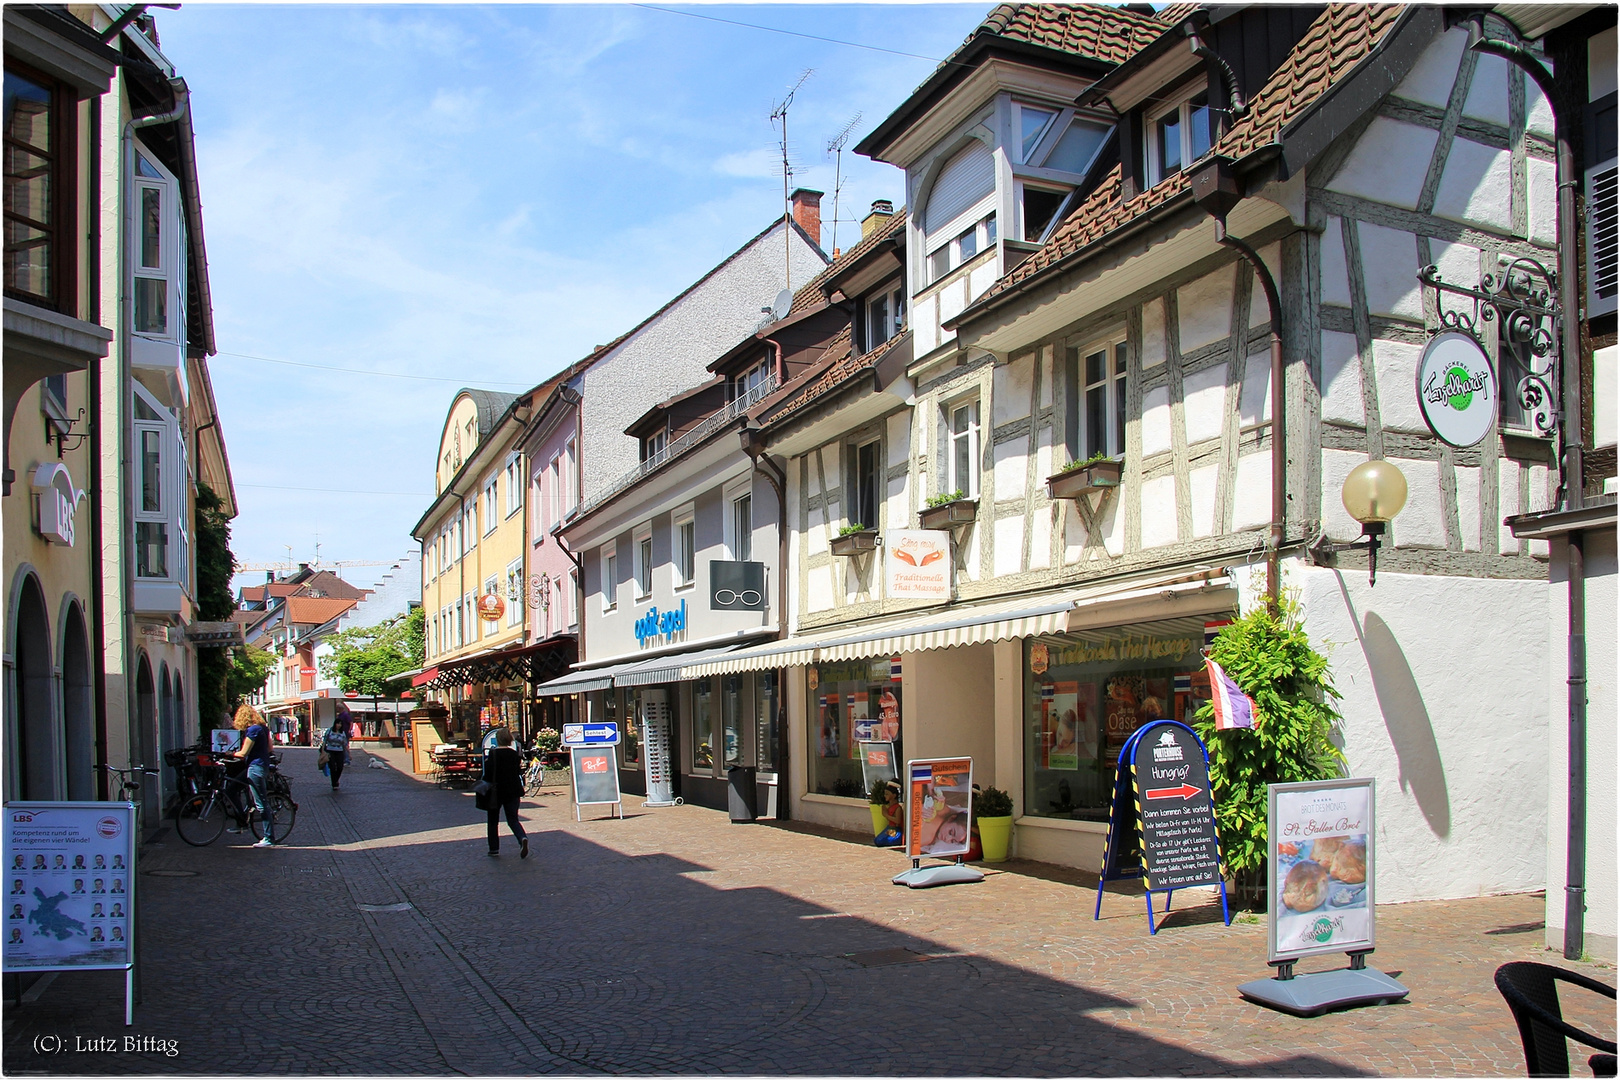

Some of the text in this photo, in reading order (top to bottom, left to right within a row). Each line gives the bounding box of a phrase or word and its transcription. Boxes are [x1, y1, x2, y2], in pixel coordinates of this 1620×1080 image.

[56, 487, 75, 548] LBS
[894, 573, 943, 582] Traditionelle
[893, 583, 945, 594] Thai Massage
[635, 598, 686, 647] optik apel
[1119, 632, 1144, 661] Thai
[1144, 635, 1191, 662] Massage
[1108, 712, 1137, 730] Oase
[931, 764, 967, 773] Gutschein
[1151, 764, 1190, 781] Hungrig?
[1144, 810, 1159, 818] Dann
[1160, 808, 1181, 817] kommen
[1182, 806, 1192, 814] Sie
[1301, 801, 1347, 814] BROT DES MONATS
[1303, 819, 1334, 836] Galler
[1335, 817, 1361, 831] Brot
[23, 837, 51, 845] eigenen
[1158, 877, 1168, 885] Wir
[1168, 875, 1185, 883] freuen
[1194, 872, 1202, 880] auf
